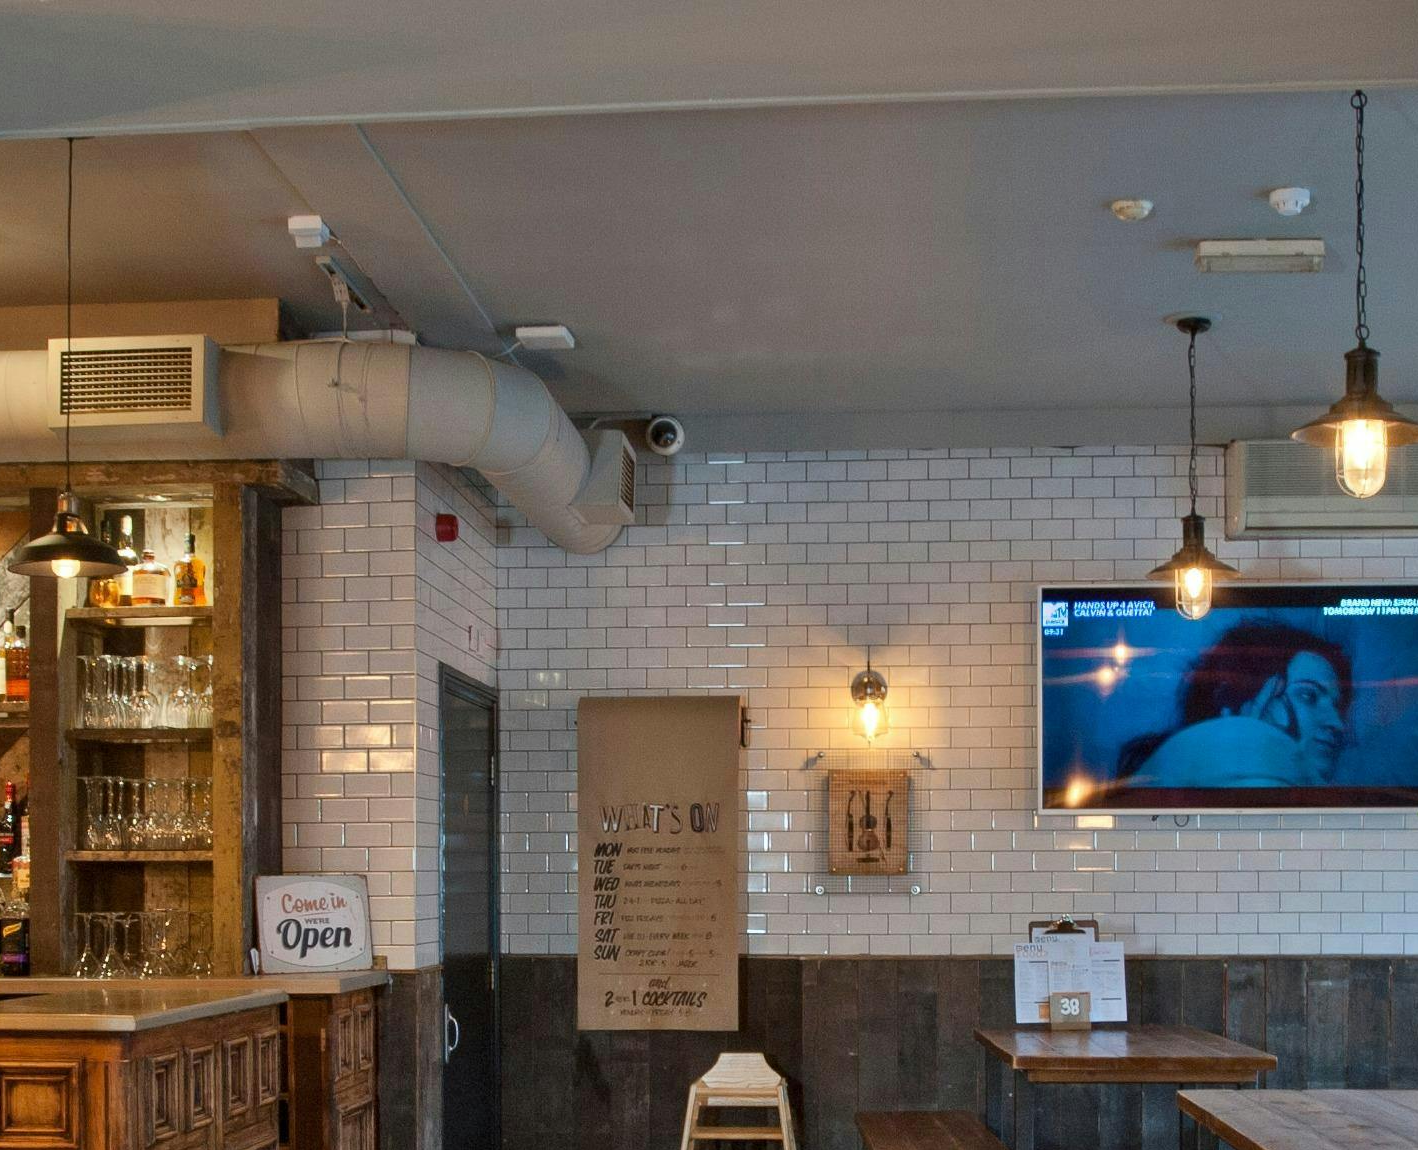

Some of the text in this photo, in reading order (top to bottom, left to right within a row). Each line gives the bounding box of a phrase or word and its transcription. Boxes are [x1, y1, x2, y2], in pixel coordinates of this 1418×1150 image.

[1073, 600, 1105, 609] HANDS
[1106, 600, 1119, 609] UP
[1340, 598, 1371, 607] BRAND
[1074, 608, 1106, 617] CALVIN
[1323, 607, 1376, 616] TOMORROW
[1400, 607, 1414, 615] ON
[600, 802, 720, 834] WHAT'S ON
[594, 842, 623, 858] MON
[593, 860, 616, 875] TUE
[594, 877, 620, 892] WED
[281, 892, 348, 914] Come in
[595, 895, 617, 910] THU
[594, 912, 615, 926] FRI
[276, 918, 353, 959] Open
[595, 928, 621, 943] SAT
[594, 945, 621, 962] SUN
[604, 990, 615, 1008] 2
[632, 990, 638, 1006] 1
[642, 991, 708, 1008] COCKTAILS
[1060, 998, 1080, 1016] 38
